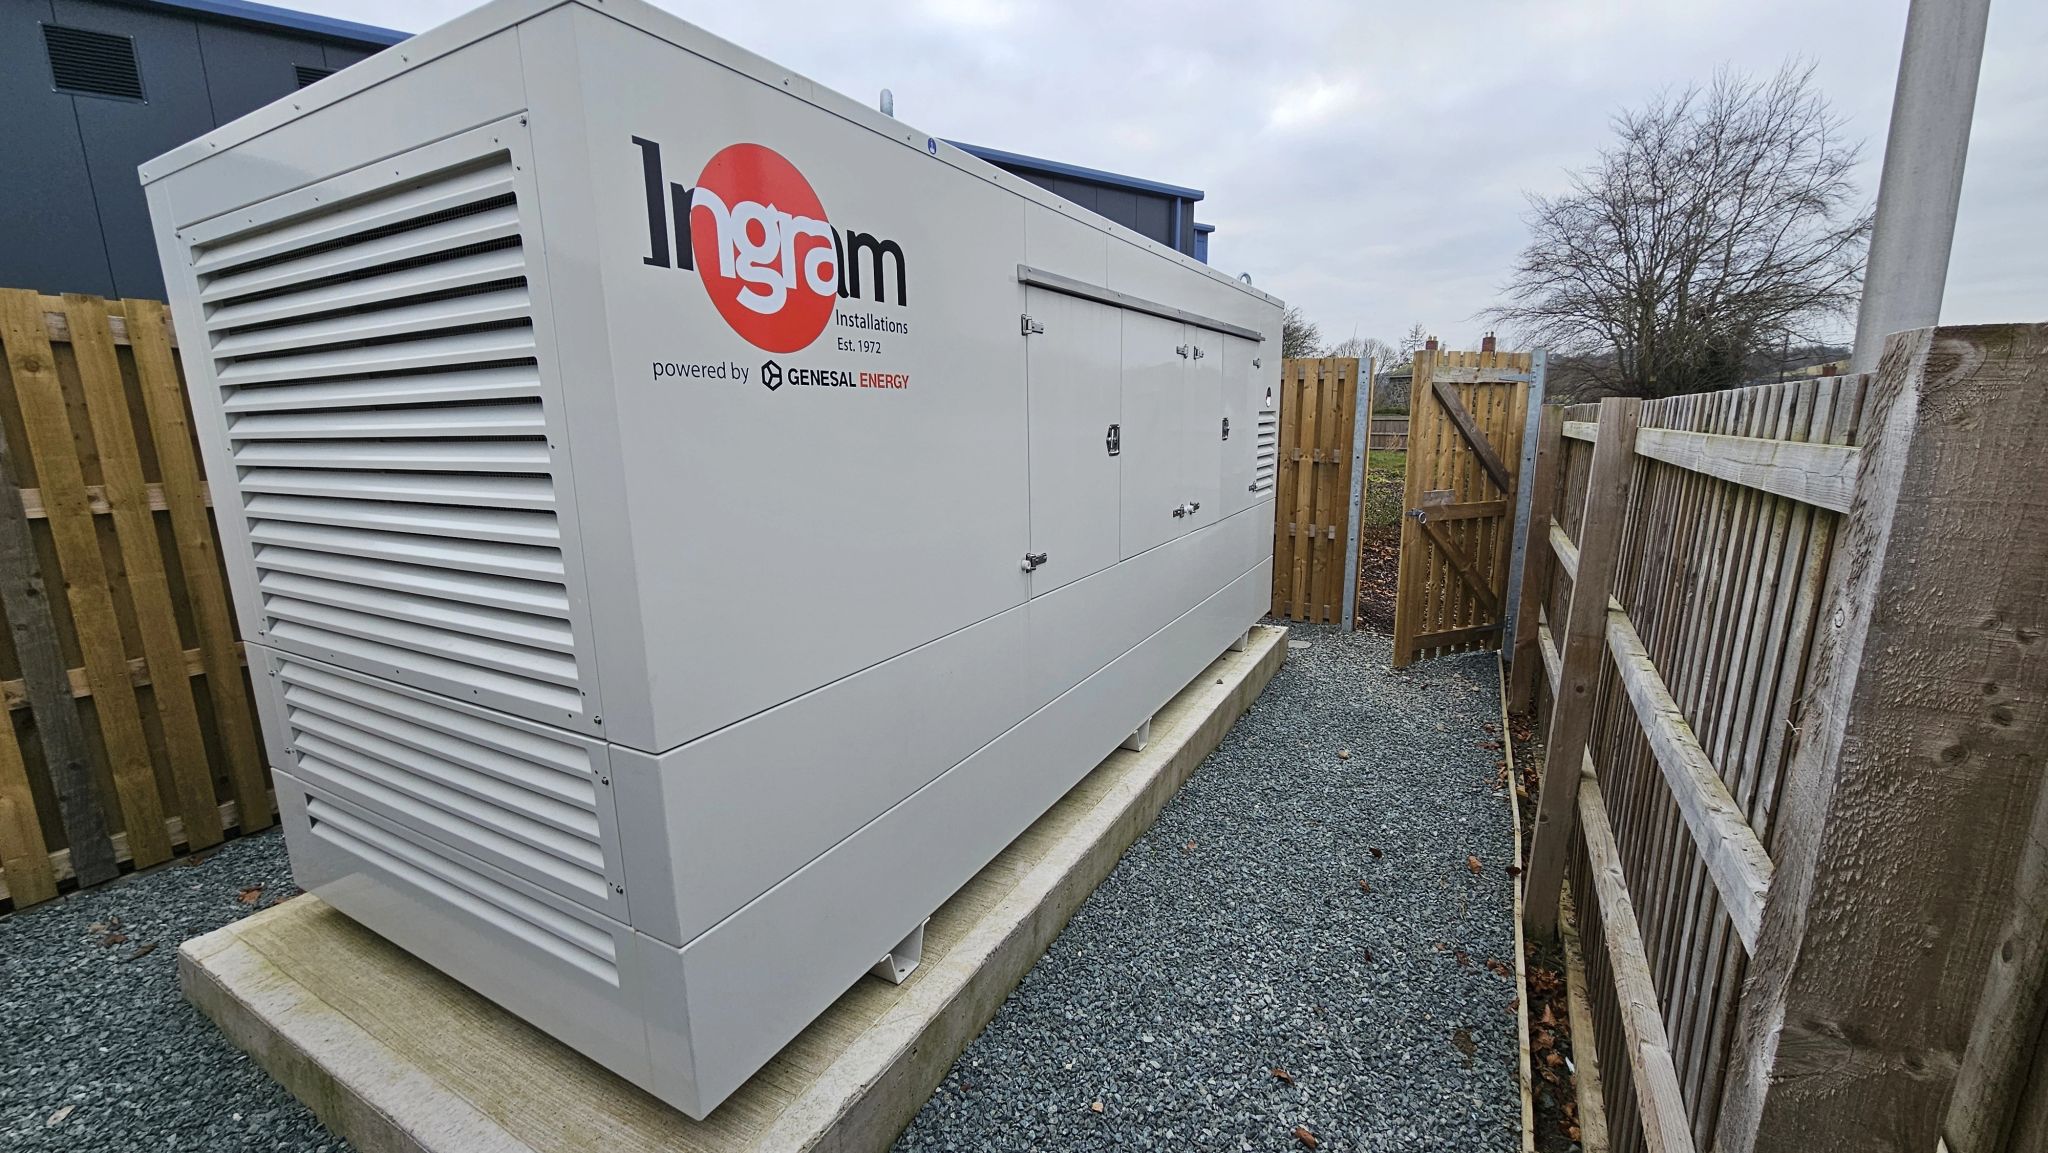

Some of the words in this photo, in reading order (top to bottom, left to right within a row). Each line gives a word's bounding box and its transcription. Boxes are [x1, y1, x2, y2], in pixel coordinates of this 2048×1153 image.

[631, 134, 908, 315] Ingram
[835, 309, 909, 335] Installations
[837, 337, 856, 352] Est.
[858, 339, 881, 354] 1972
[652, 361, 726, 381] powered
[730, 361, 749, 384] by
[787, 367, 857, 388] GENESAL
[859, 372, 909, 390] ENERGY
